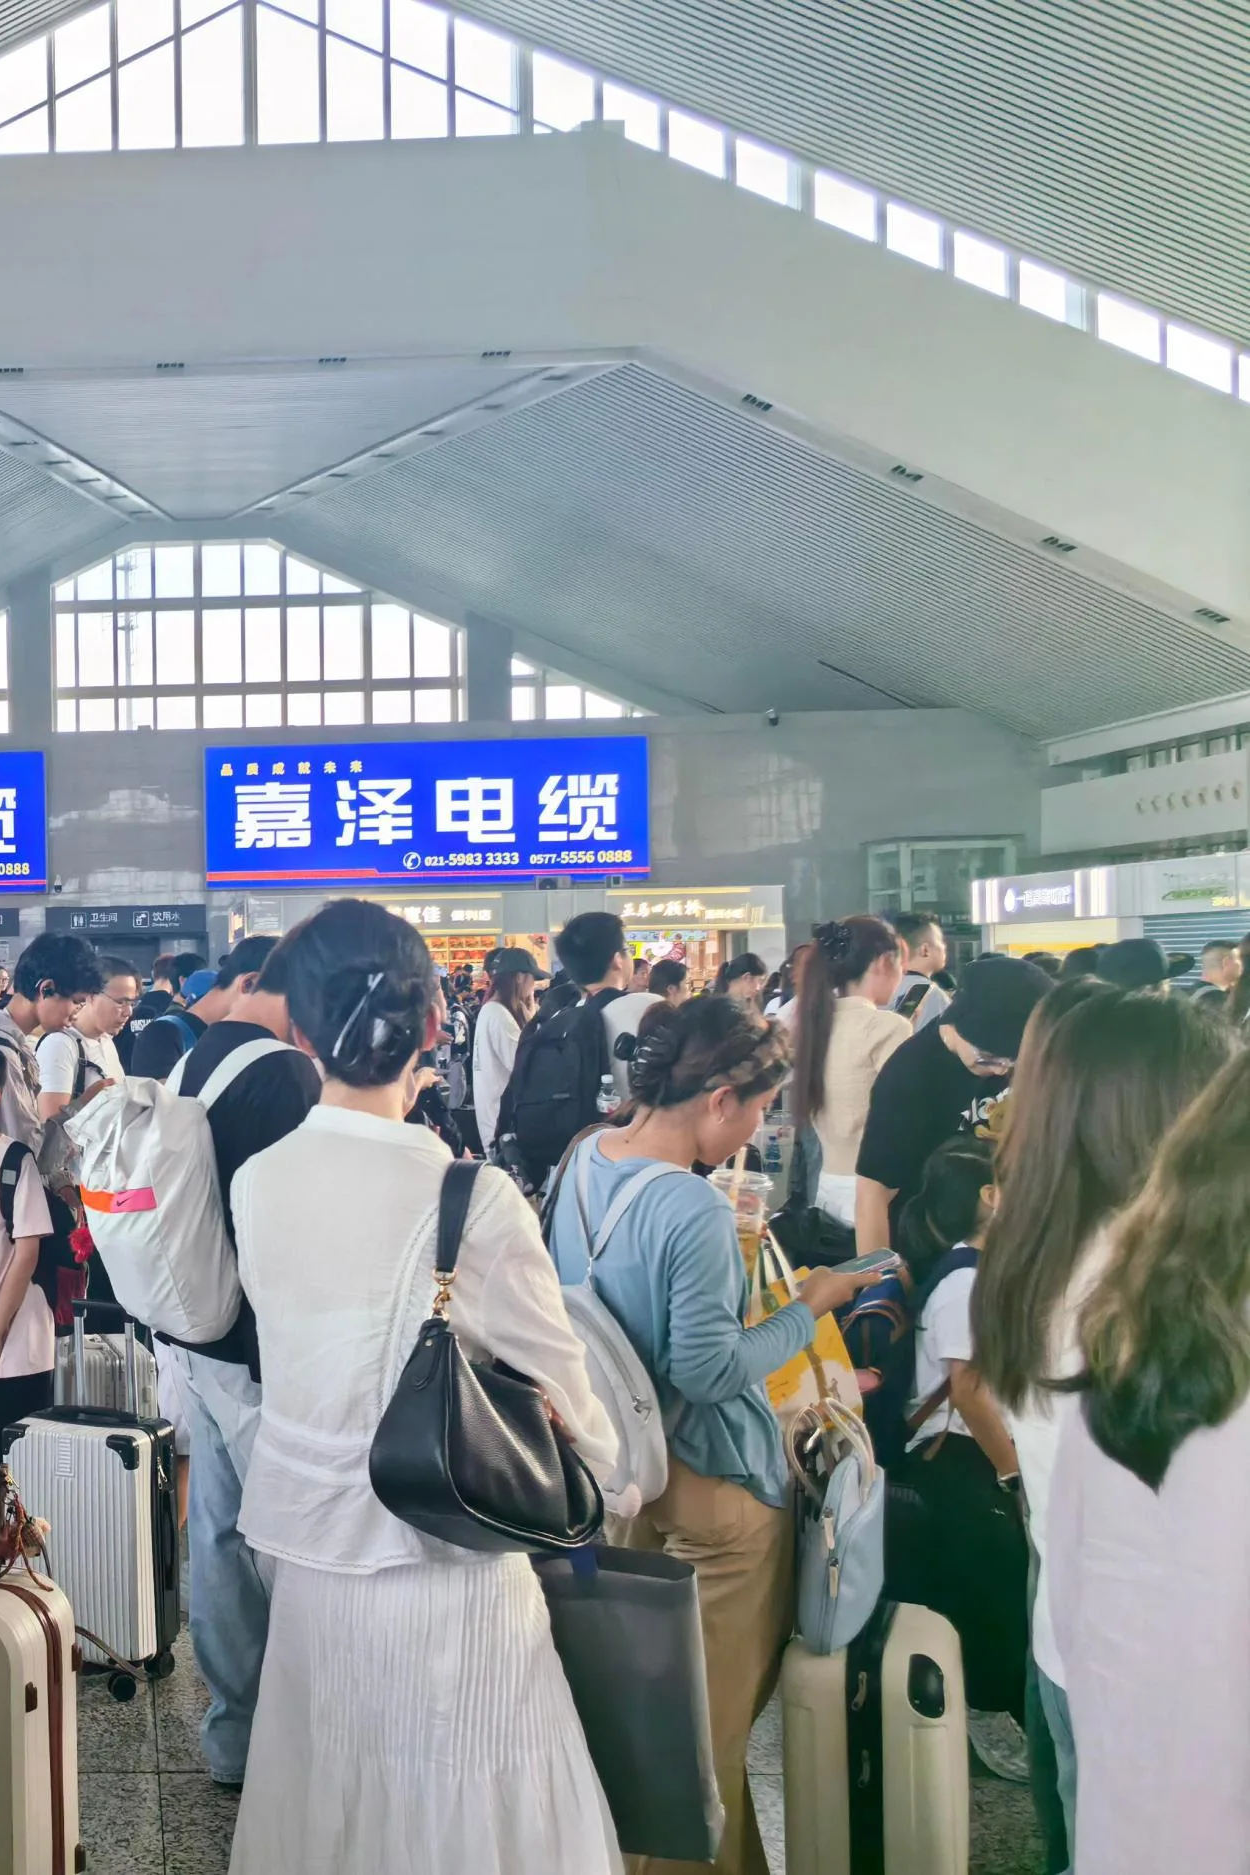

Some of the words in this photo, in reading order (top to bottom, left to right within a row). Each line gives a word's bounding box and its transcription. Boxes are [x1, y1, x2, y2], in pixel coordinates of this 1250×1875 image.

[235, 774, 619, 848] 嘉泽电缆
[424, 853, 482, 866] 021-5983
[485, 852, 519, 865] 3333
[529, 850, 595, 864] 0577-5556
[597, 850, 632, 863] 0888
